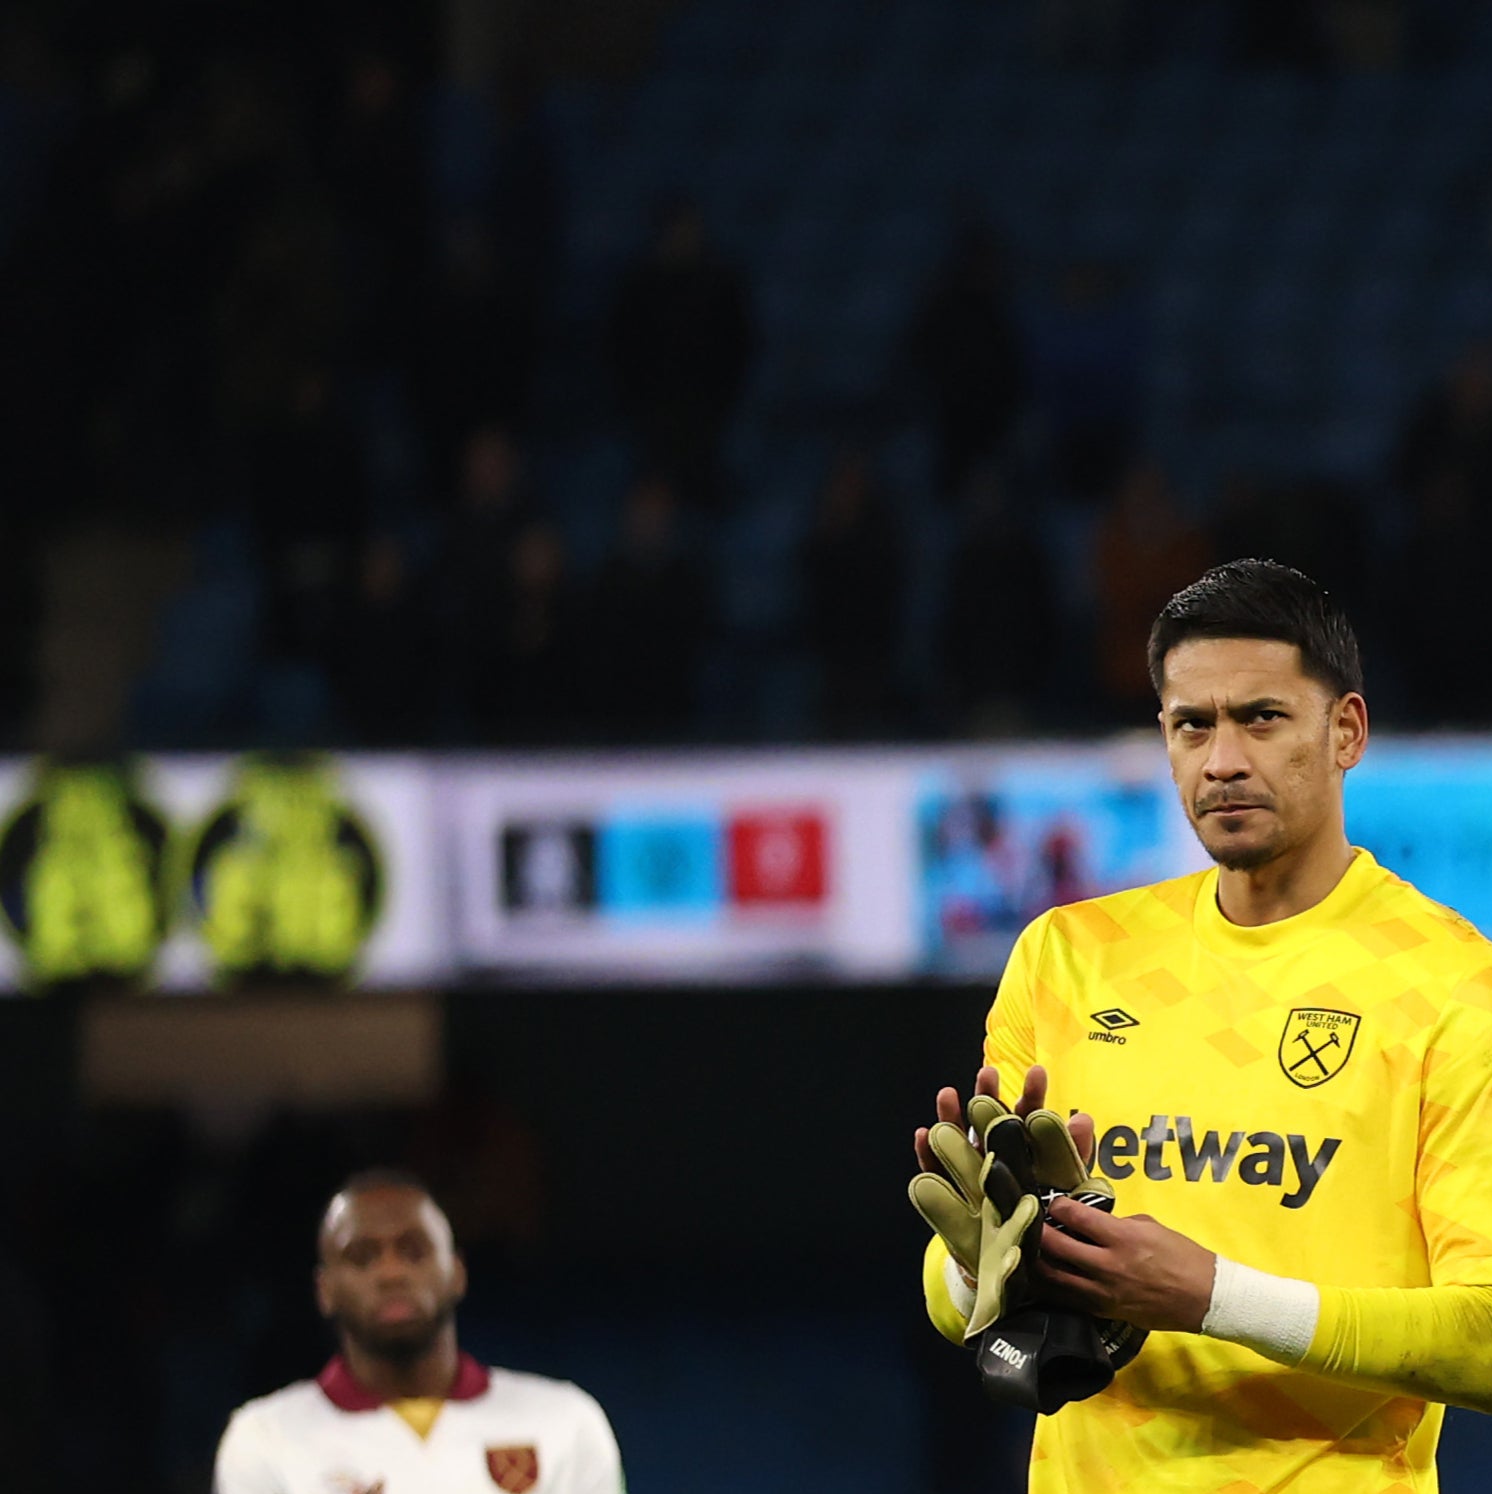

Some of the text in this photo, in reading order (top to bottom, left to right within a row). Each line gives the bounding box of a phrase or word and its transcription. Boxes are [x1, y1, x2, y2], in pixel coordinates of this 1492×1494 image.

[1297, 1012, 1352, 1025] WEST HAM
[1306, 1021, 1339, 1030] UNITED
[1088, 1031, 1127, 1045] umbro
[989, 1338, 1028, 1369] FONZI
